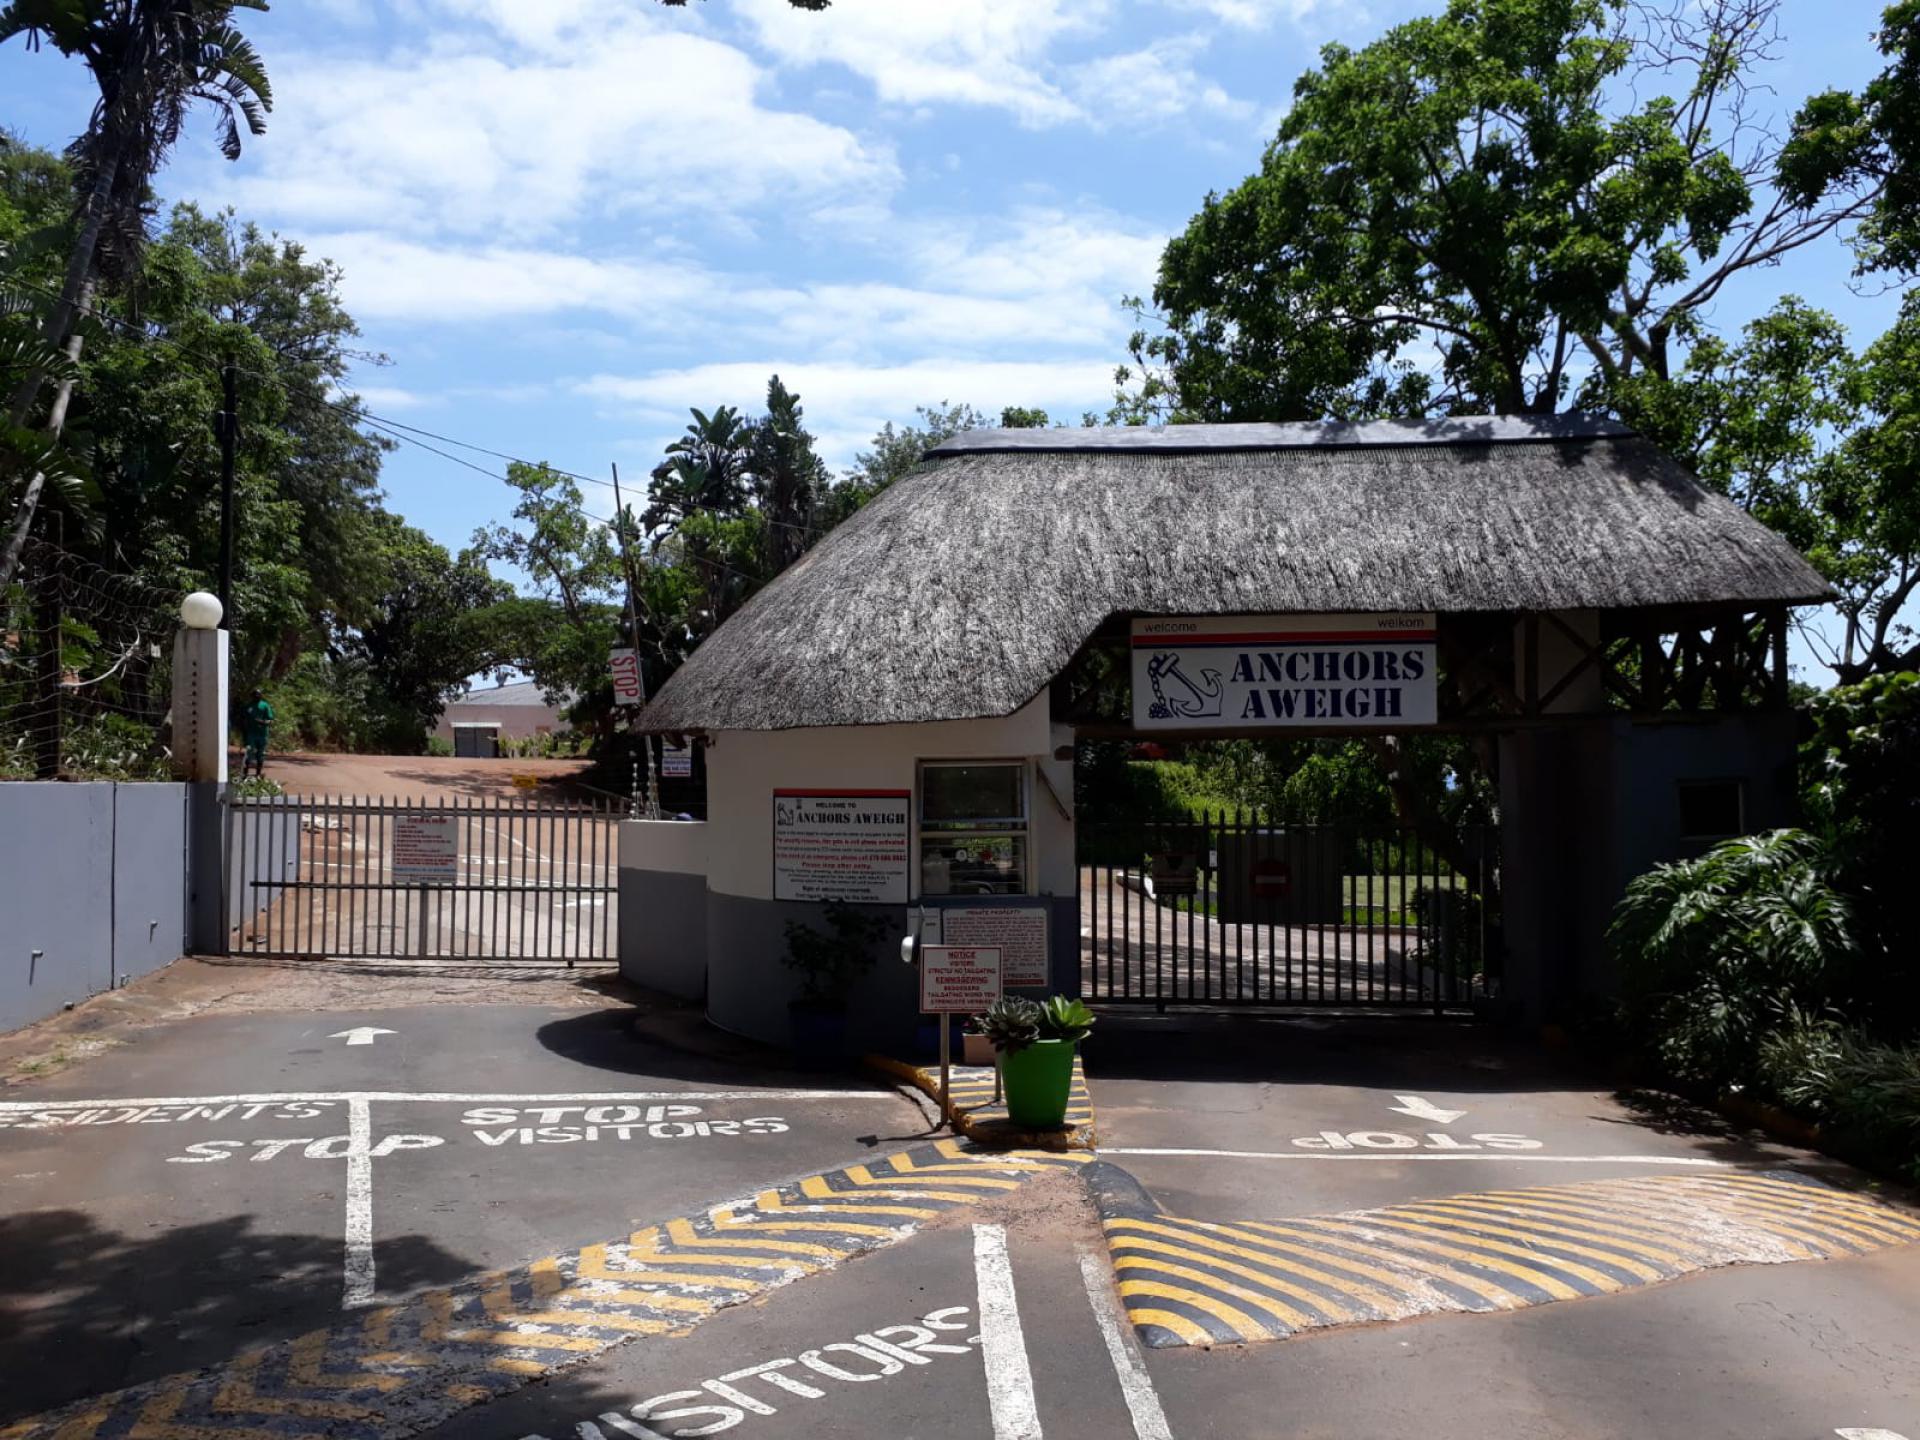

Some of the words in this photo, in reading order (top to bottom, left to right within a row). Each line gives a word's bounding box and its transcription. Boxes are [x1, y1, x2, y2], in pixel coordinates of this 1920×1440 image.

[1143, 621, 1197, 632] welcome
[1377, 615, 1425, 629] welkom
[608, 655, 639, 698] STOP
[1230, 650, 1424, 683] ANCHORS
[1240, 687, 1402, 719] AWEIGH
[796, 812, 850, 824] ANCHORS
[854, 813, 905, 825] AWEIGH
[948, 951, 976, 959] NOTICE
[460, 1104, 703, 1125] STOP
[472, 1116, 790, 1146] VISITORS
[1290, 1131, 1544, 1150] STOP
[166, 1133, 445, 1163] STOP
